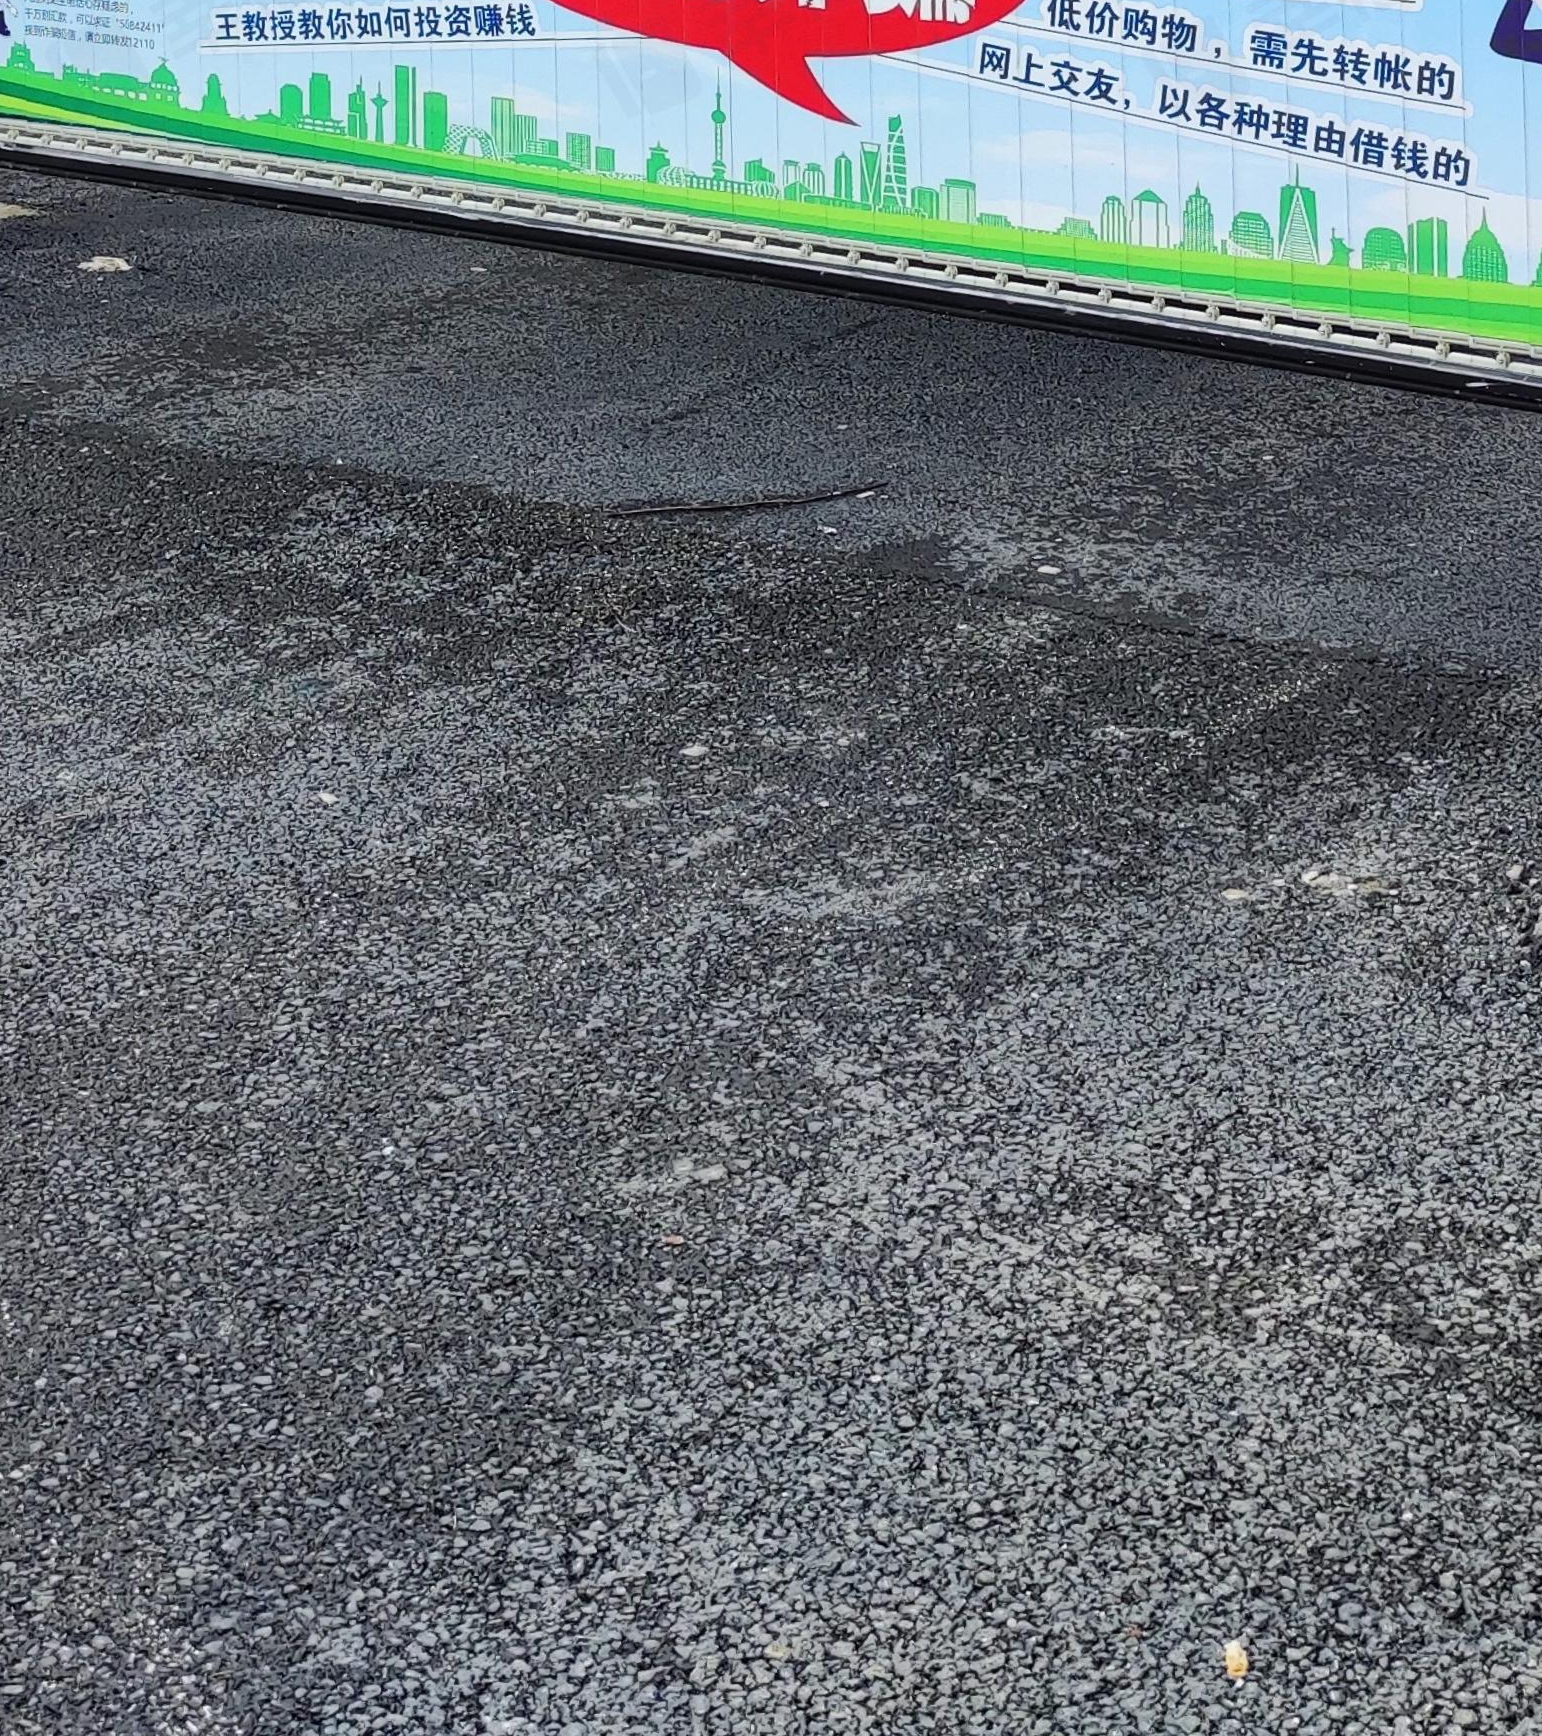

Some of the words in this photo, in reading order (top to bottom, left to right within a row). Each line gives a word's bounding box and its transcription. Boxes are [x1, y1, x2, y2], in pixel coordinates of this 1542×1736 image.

[214, 2, 536, 42] 王教授教你如何投资赚钱
[979, 42, 1471, 187] 网上交友，以各种理由借钱的
